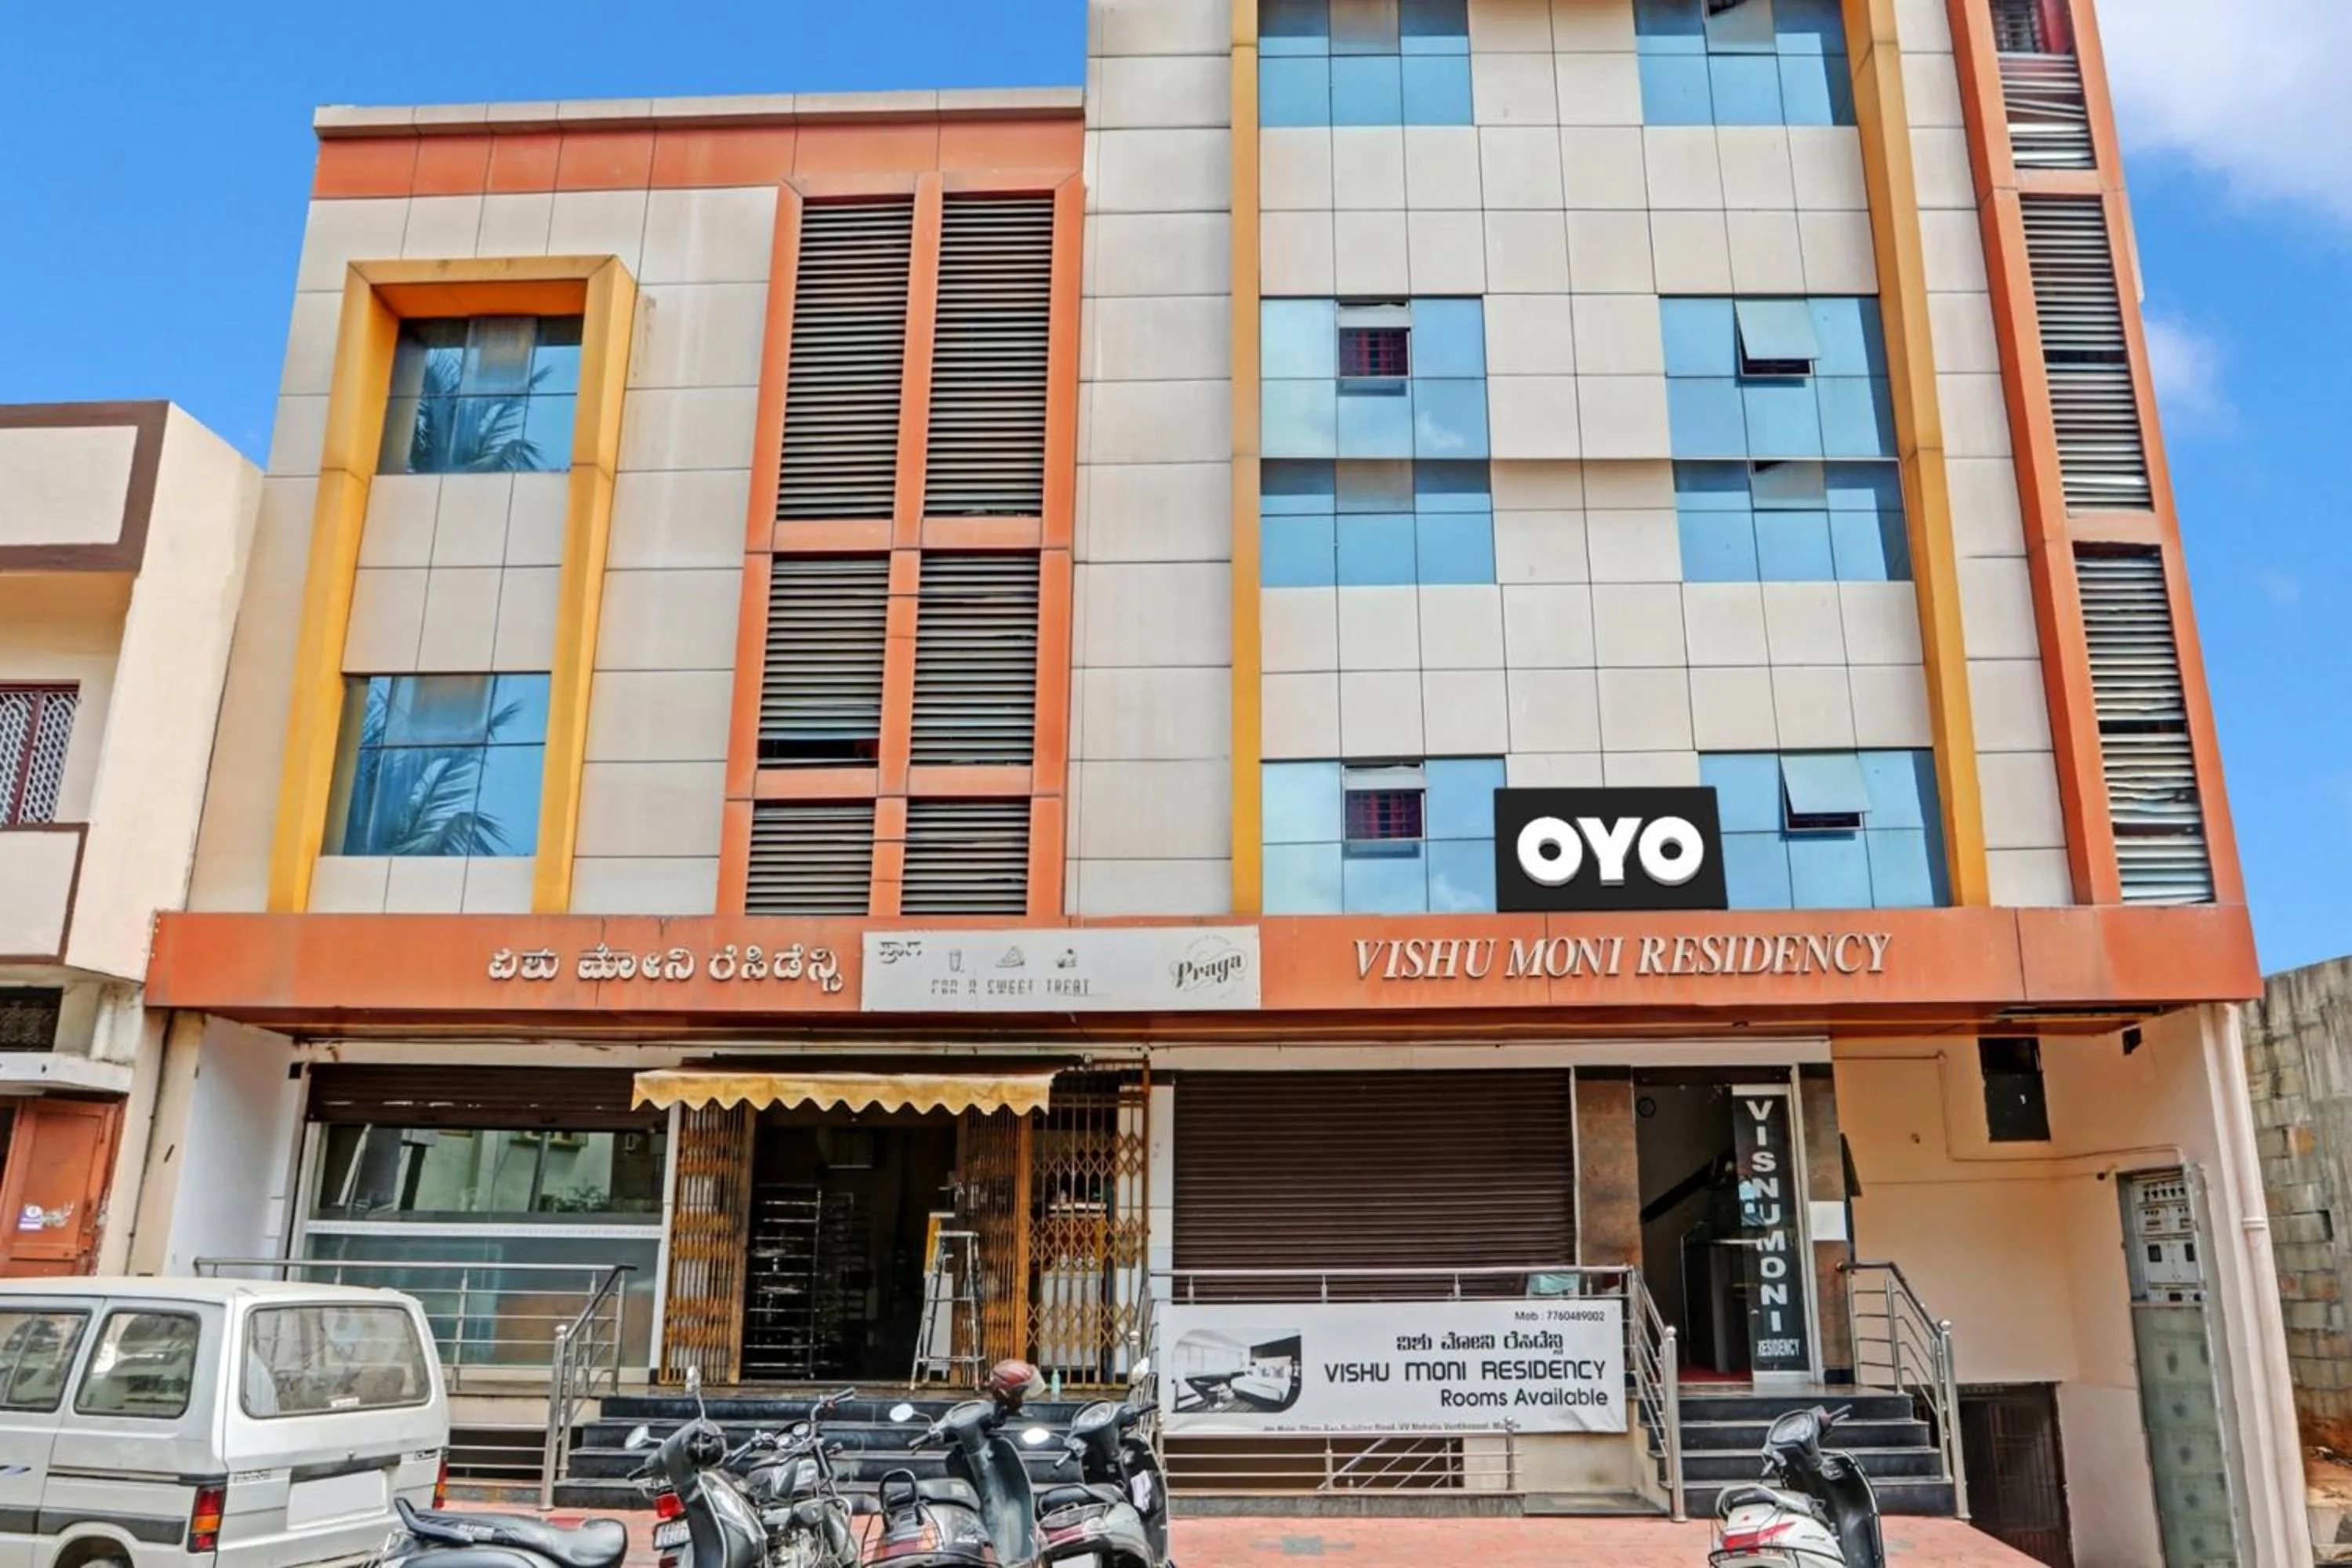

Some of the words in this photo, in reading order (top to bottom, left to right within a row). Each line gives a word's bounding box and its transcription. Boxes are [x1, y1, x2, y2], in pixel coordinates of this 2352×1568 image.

[1516, 815, 1704, 887] OYO
[1354, 937, 1497, 979] VISHU
[1505, 936, 1626, 978] MONI
[1635, 932, 1893, 975] RESIDENCY
[1175, 954, 1243, 989] Praga
[987, 978, 1033, 995] SWEET
[1046, 978, 1091, 996] TREAT
[1324, 1363, 1389, 1382] VISHU
[1482, 1360, 1606, 1380] RESIDENCY
[1440, 1390, 1508, 1407] Rooms
[1515, 1388, 1609, 1406] Available
